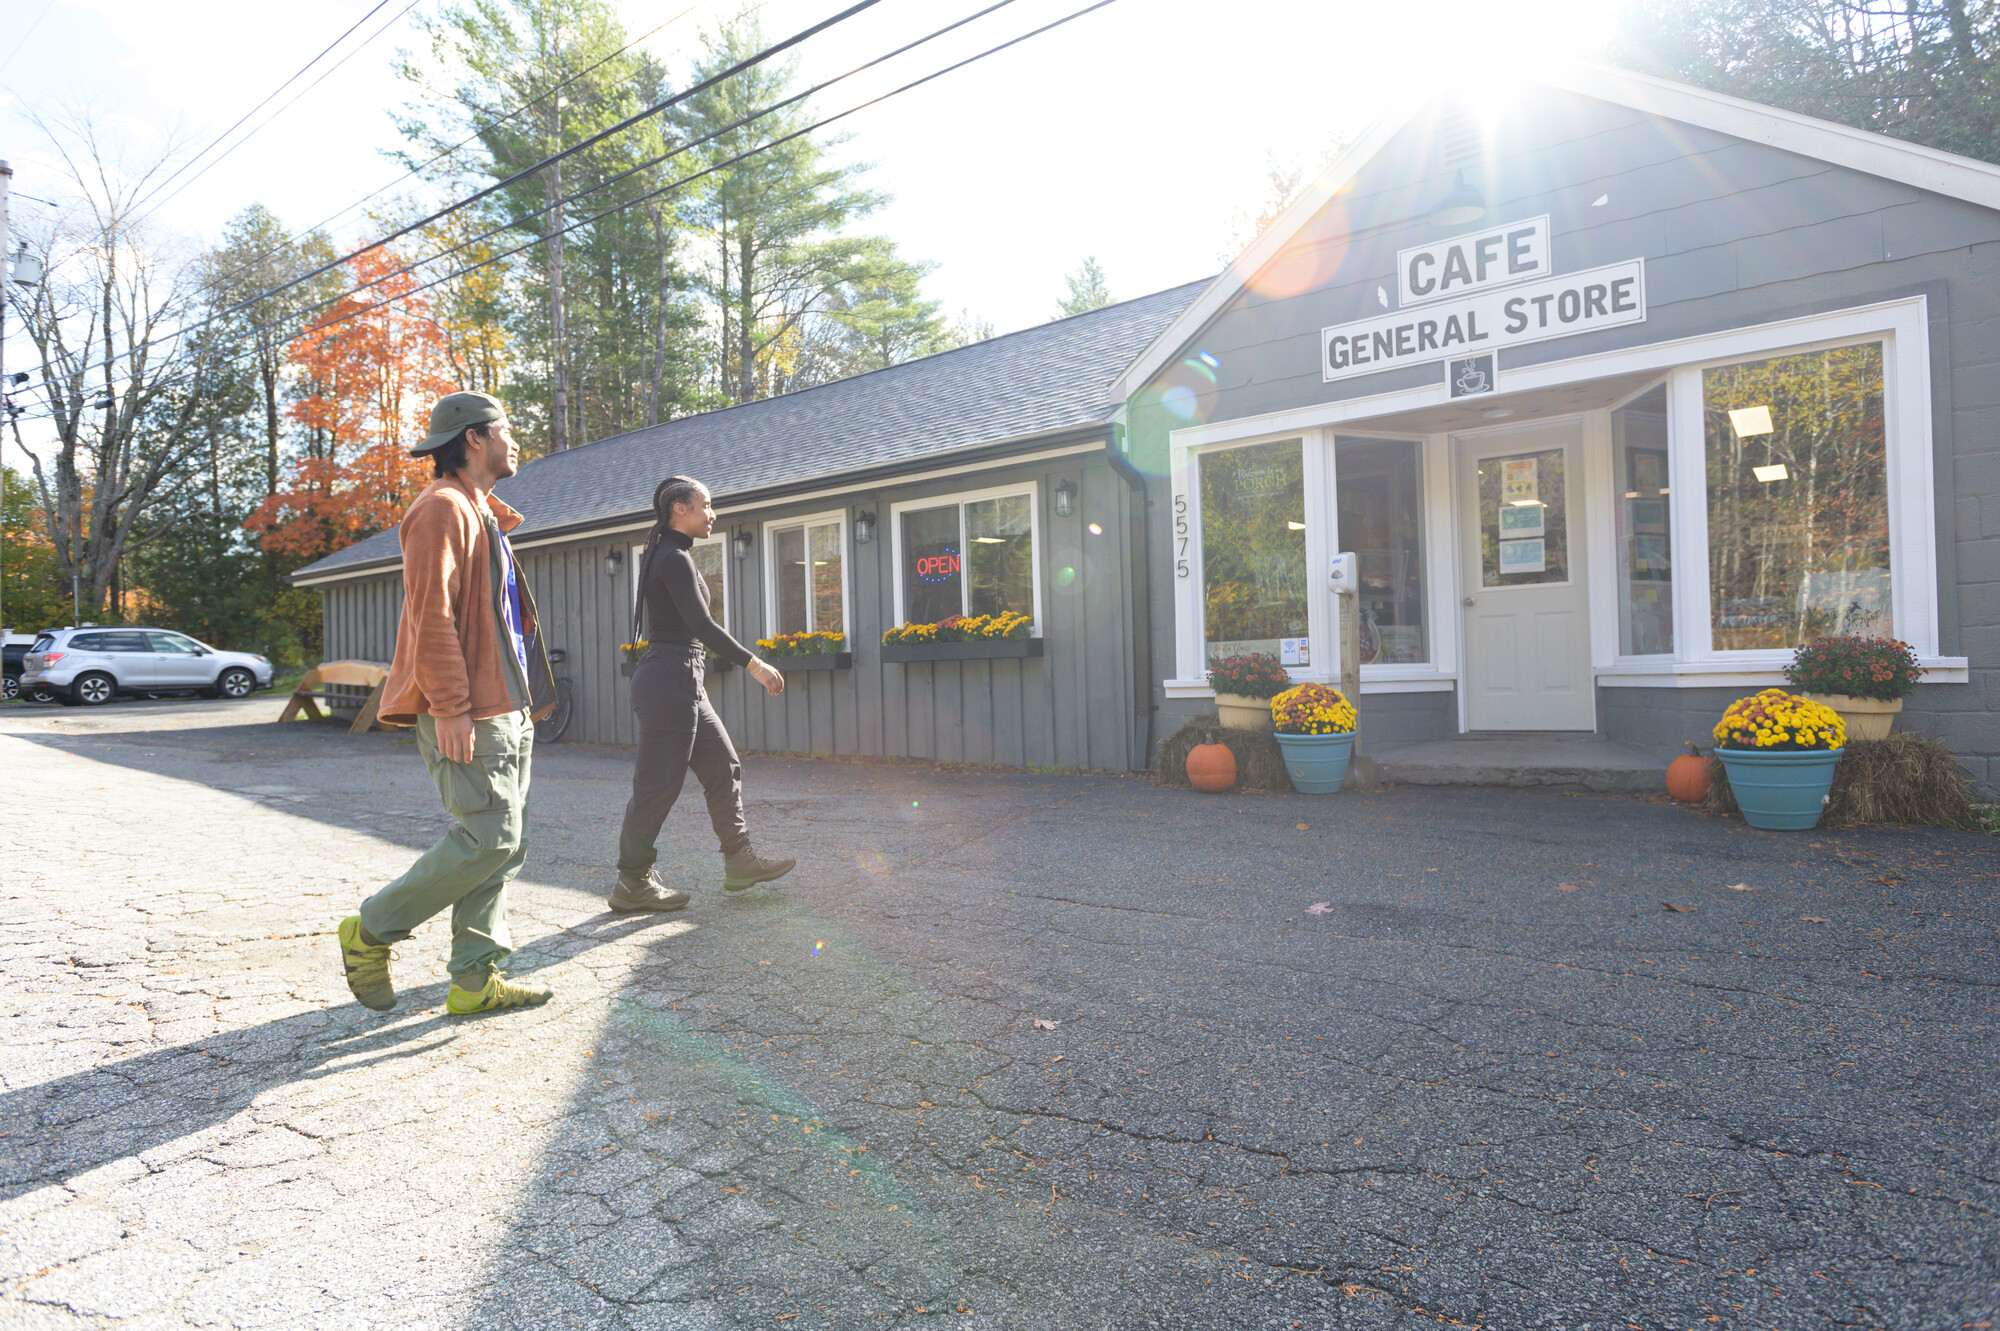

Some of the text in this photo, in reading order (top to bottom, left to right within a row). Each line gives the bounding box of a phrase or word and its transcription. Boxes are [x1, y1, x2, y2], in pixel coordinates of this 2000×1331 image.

[1408, 226, 1540, 297] CAFE
[1328, 276, 1637, 370] GENERAL STORE
[1234, 473, 1288, 491] PORCH
[917, 554, 960, 575] OPEN
[1174, 494, 1189, 578] 5575
